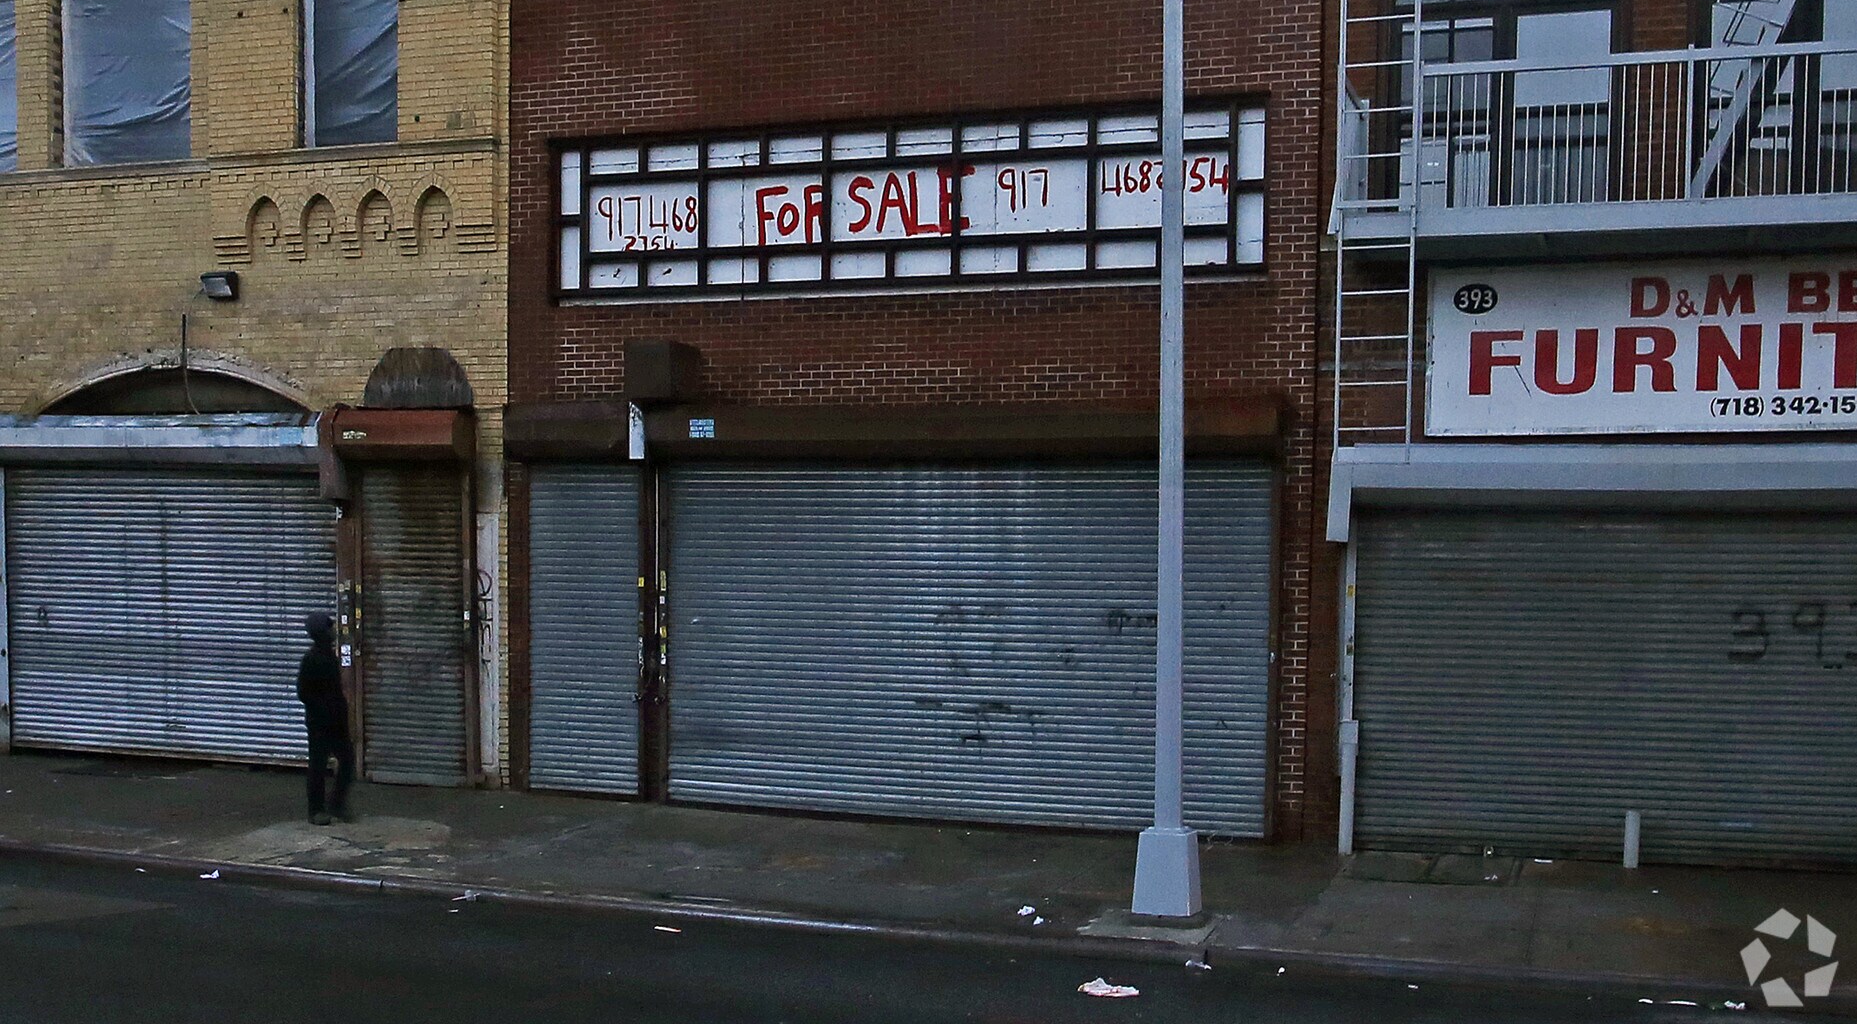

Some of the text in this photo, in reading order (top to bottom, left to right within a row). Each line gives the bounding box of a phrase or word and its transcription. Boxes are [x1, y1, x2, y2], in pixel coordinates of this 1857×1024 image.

[756, 165, 975, 246] FOR SALE
[997, 157, 1229, 213] 917 46854
[1458, 290, 1493, 308] 393
[1630, 274, 1757, 318] D&M
[1468, 322, 1857, 396] FURNIT
[1710, 397, 1764, 417] (718)
[1727, 600, 1857, 661] 39
